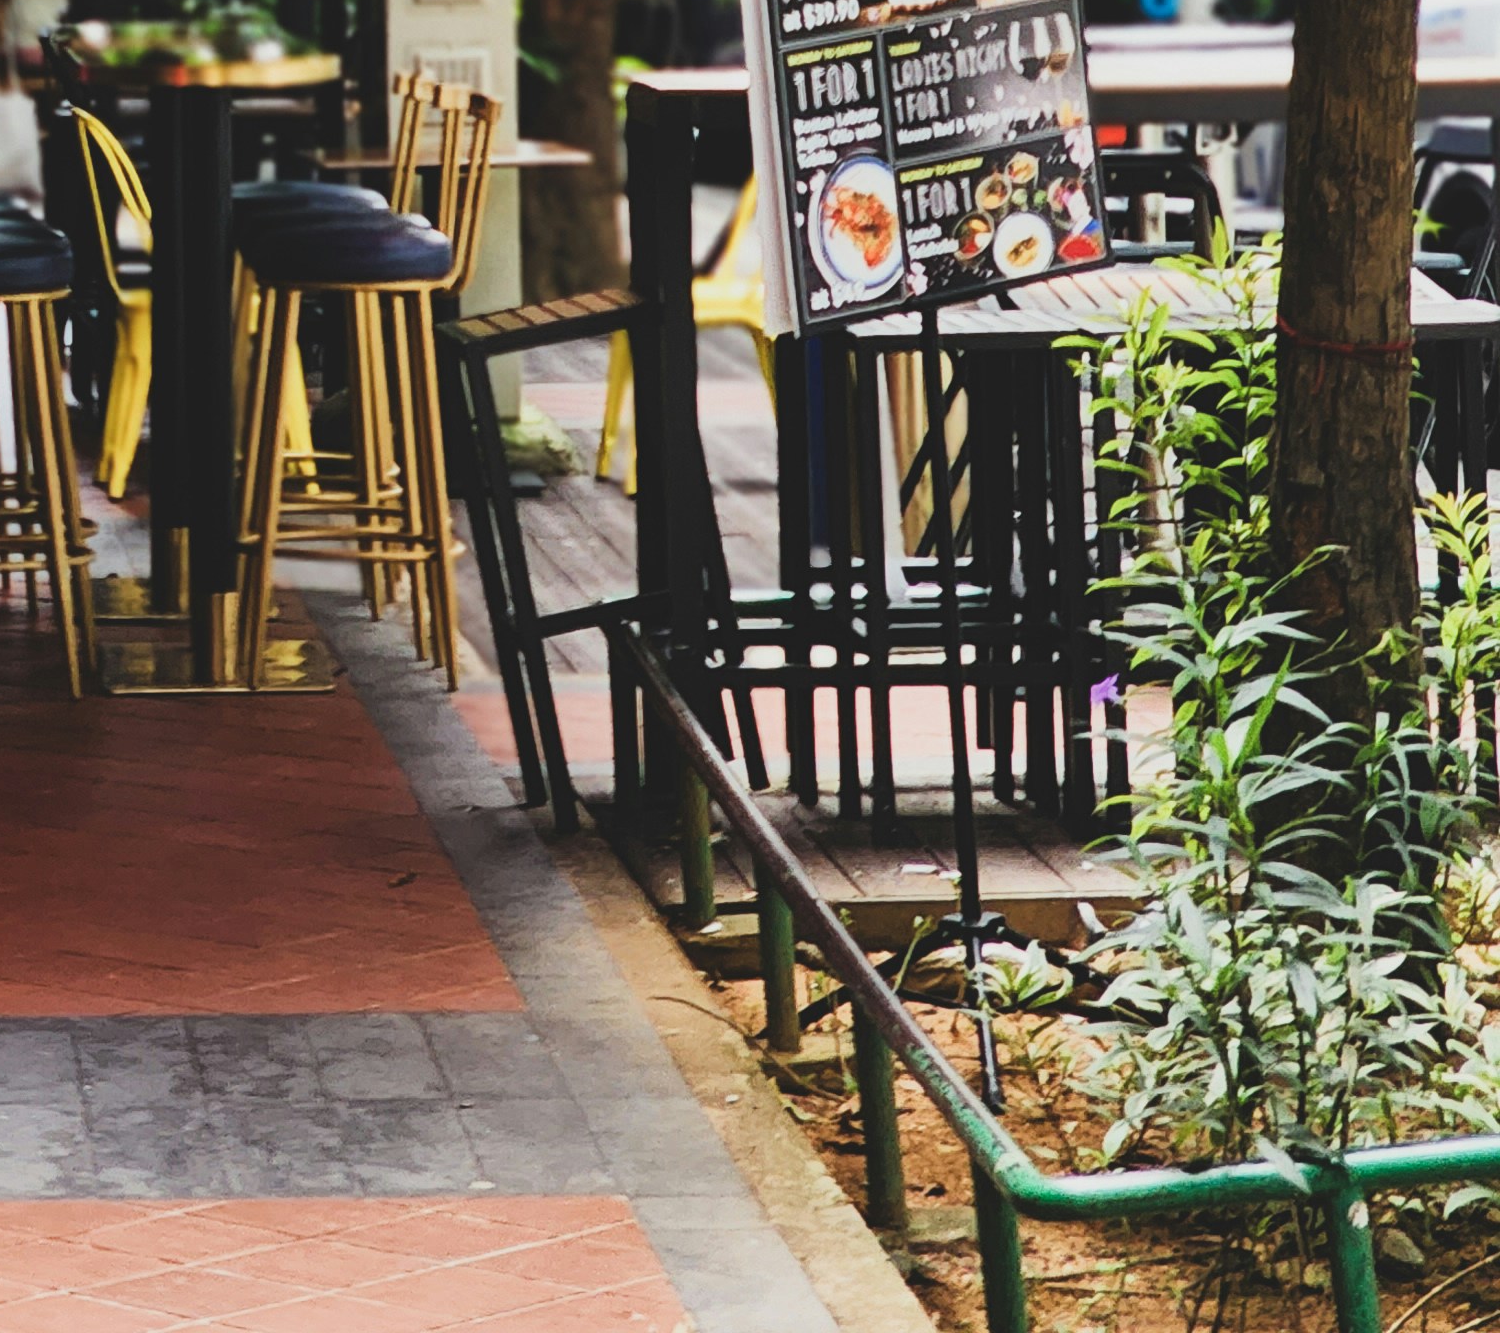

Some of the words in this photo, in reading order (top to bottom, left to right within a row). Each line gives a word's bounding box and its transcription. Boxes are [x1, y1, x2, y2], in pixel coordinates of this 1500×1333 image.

[793, 69, 808, 112] 1
[810, 61, 861, 110] FOR
[860, 58, 876, 100] 1
[891, 51, 955, 92] LADIES
[905, 89, 940, 124] FOR
[902, 188, 915, 225] 1
[916, 179, 960, 223] FOR
[960, 176, 973, 213] 1
